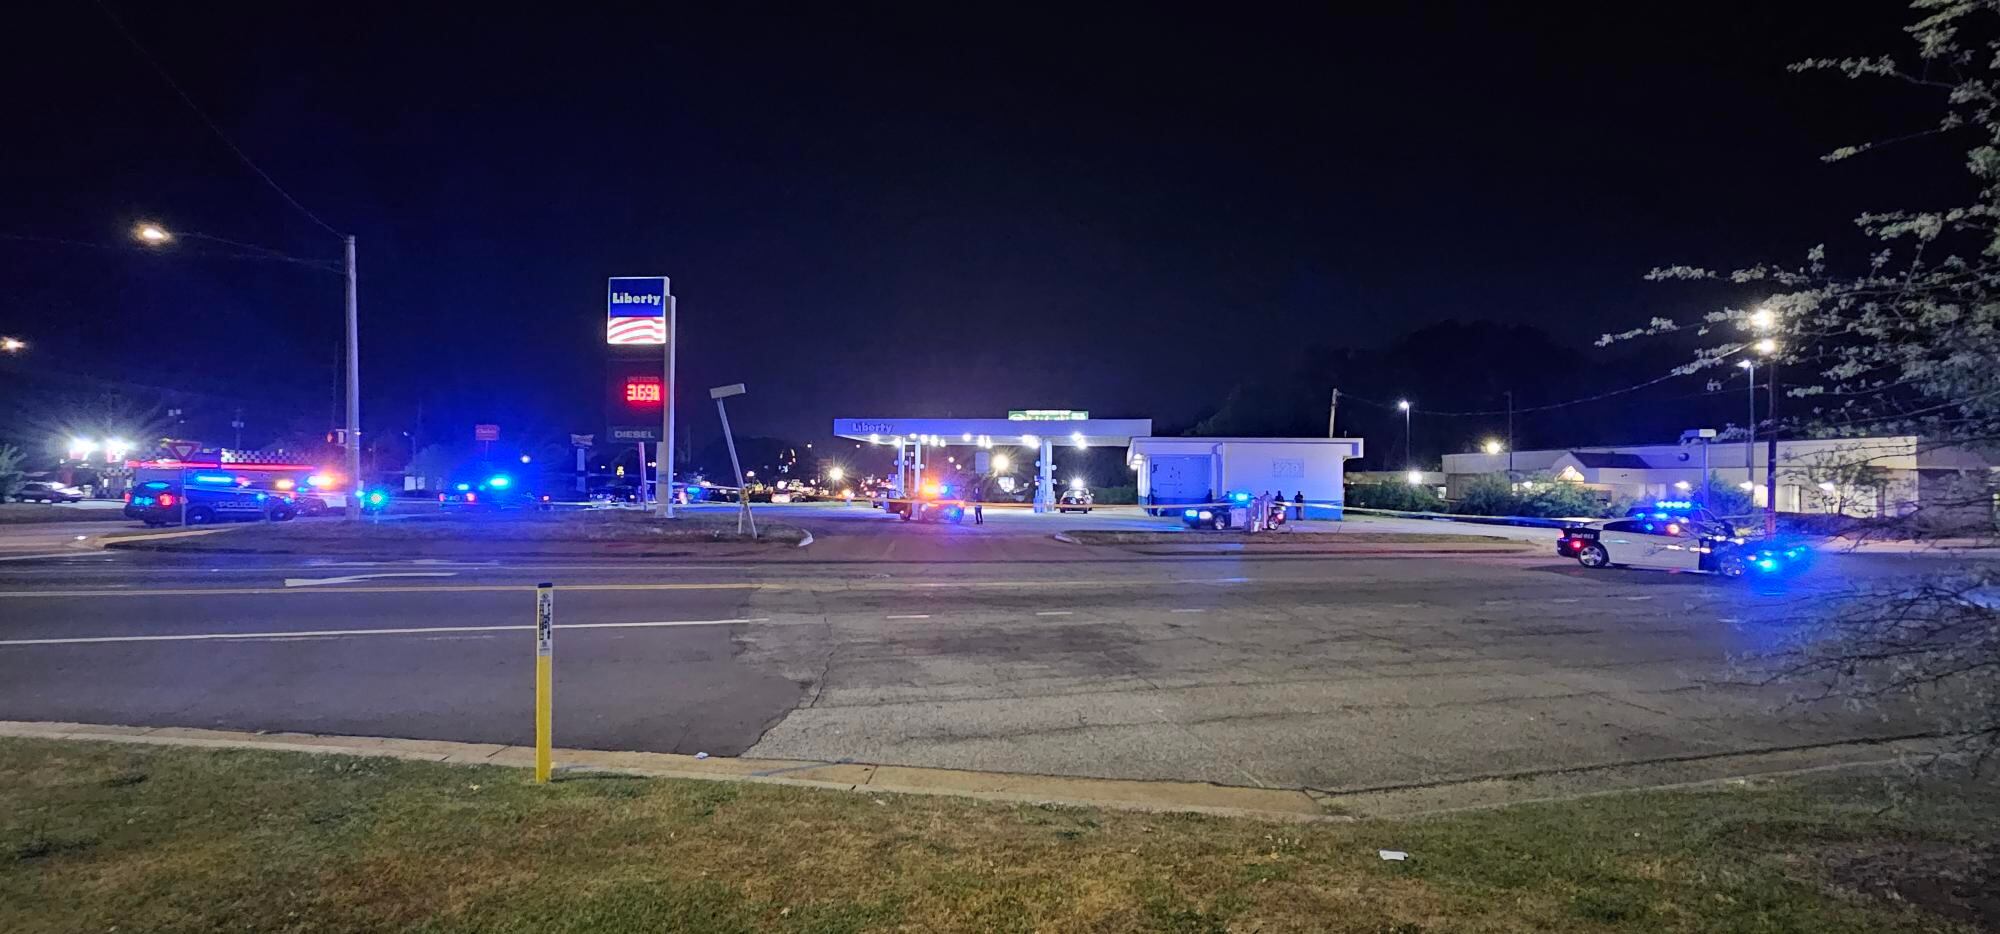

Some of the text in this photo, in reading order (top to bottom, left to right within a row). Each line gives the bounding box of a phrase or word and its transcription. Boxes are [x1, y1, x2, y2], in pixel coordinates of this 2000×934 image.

[612, 292, 661, 306] Liberty
[852, 422, 893, 434] Liberty
[614, 430, 655, 439] DIESEL
